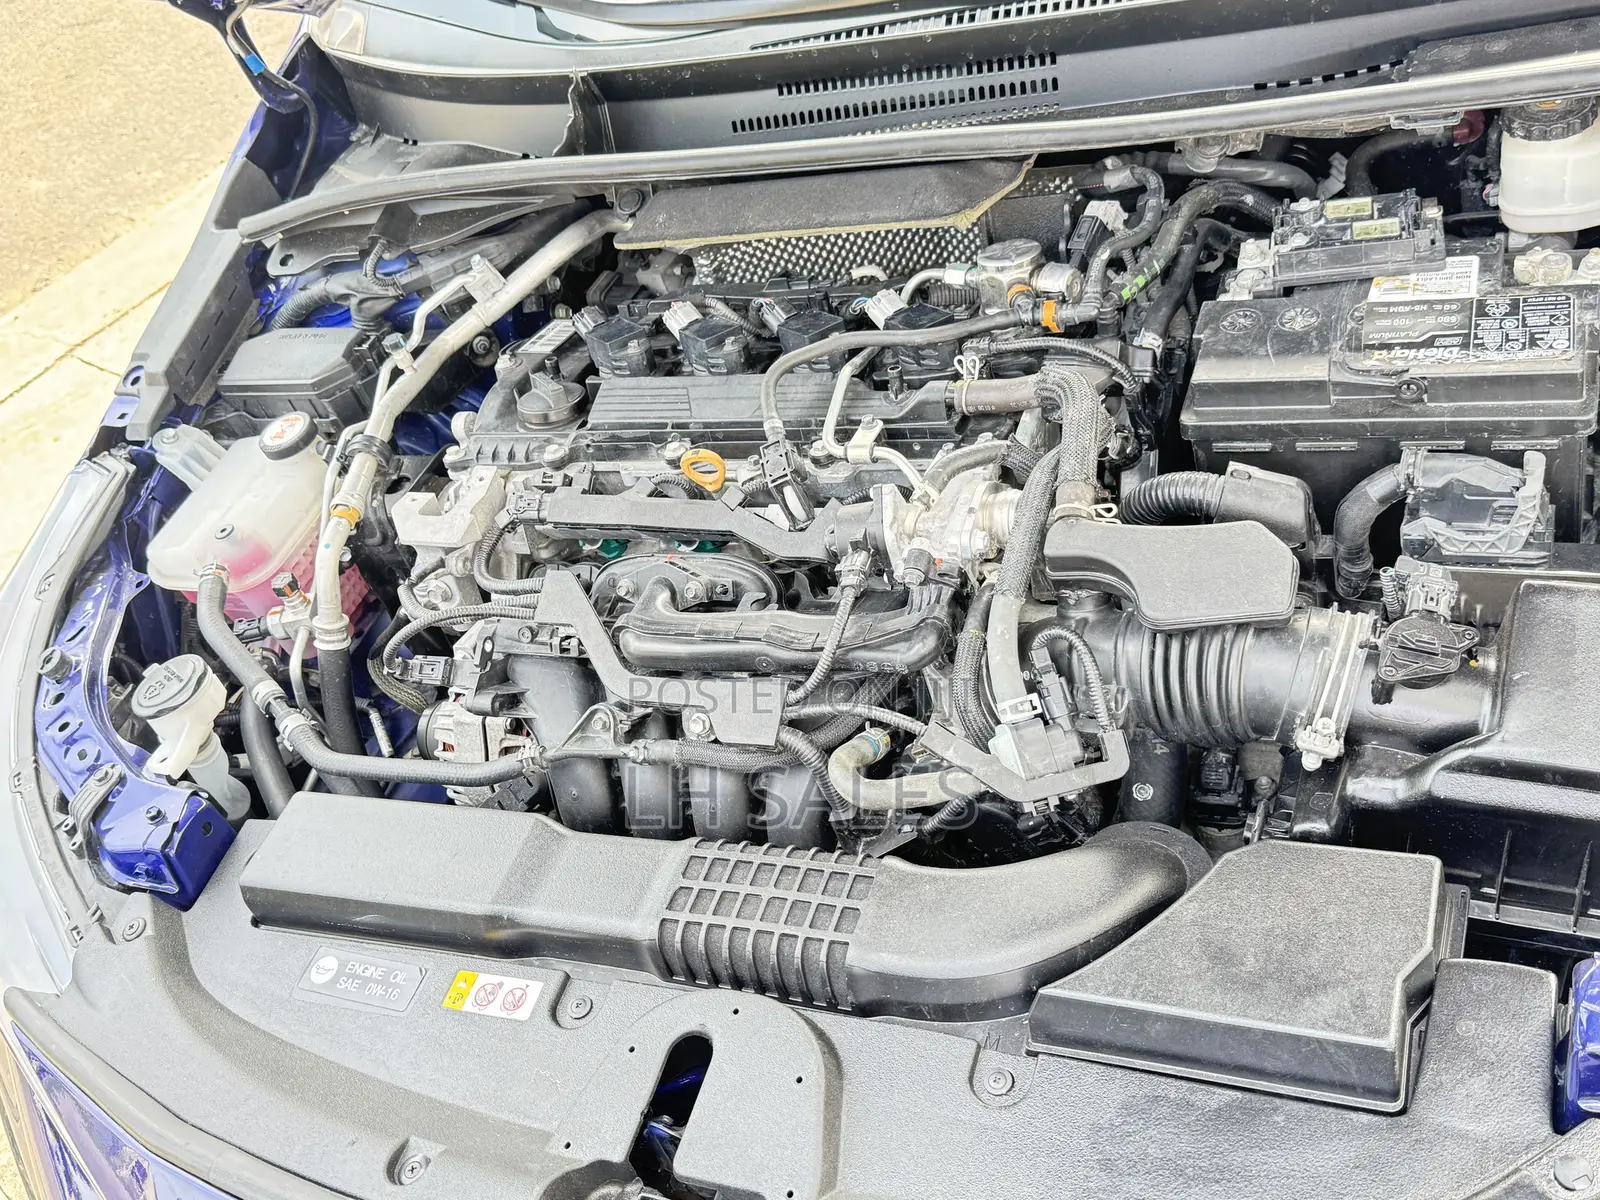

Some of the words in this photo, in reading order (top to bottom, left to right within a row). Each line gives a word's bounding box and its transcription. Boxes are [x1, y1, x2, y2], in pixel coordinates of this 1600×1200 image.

[1393, 318, 1410, 326] 100
[1368, 331, 1420, 340] PLATINUM
[345, 961, 387, 980] ENGINE
[389, 970, 408, 985] OIL
[336, 976, 362, 992] SAE
[364, 982, 401, 1001] 0W-16
